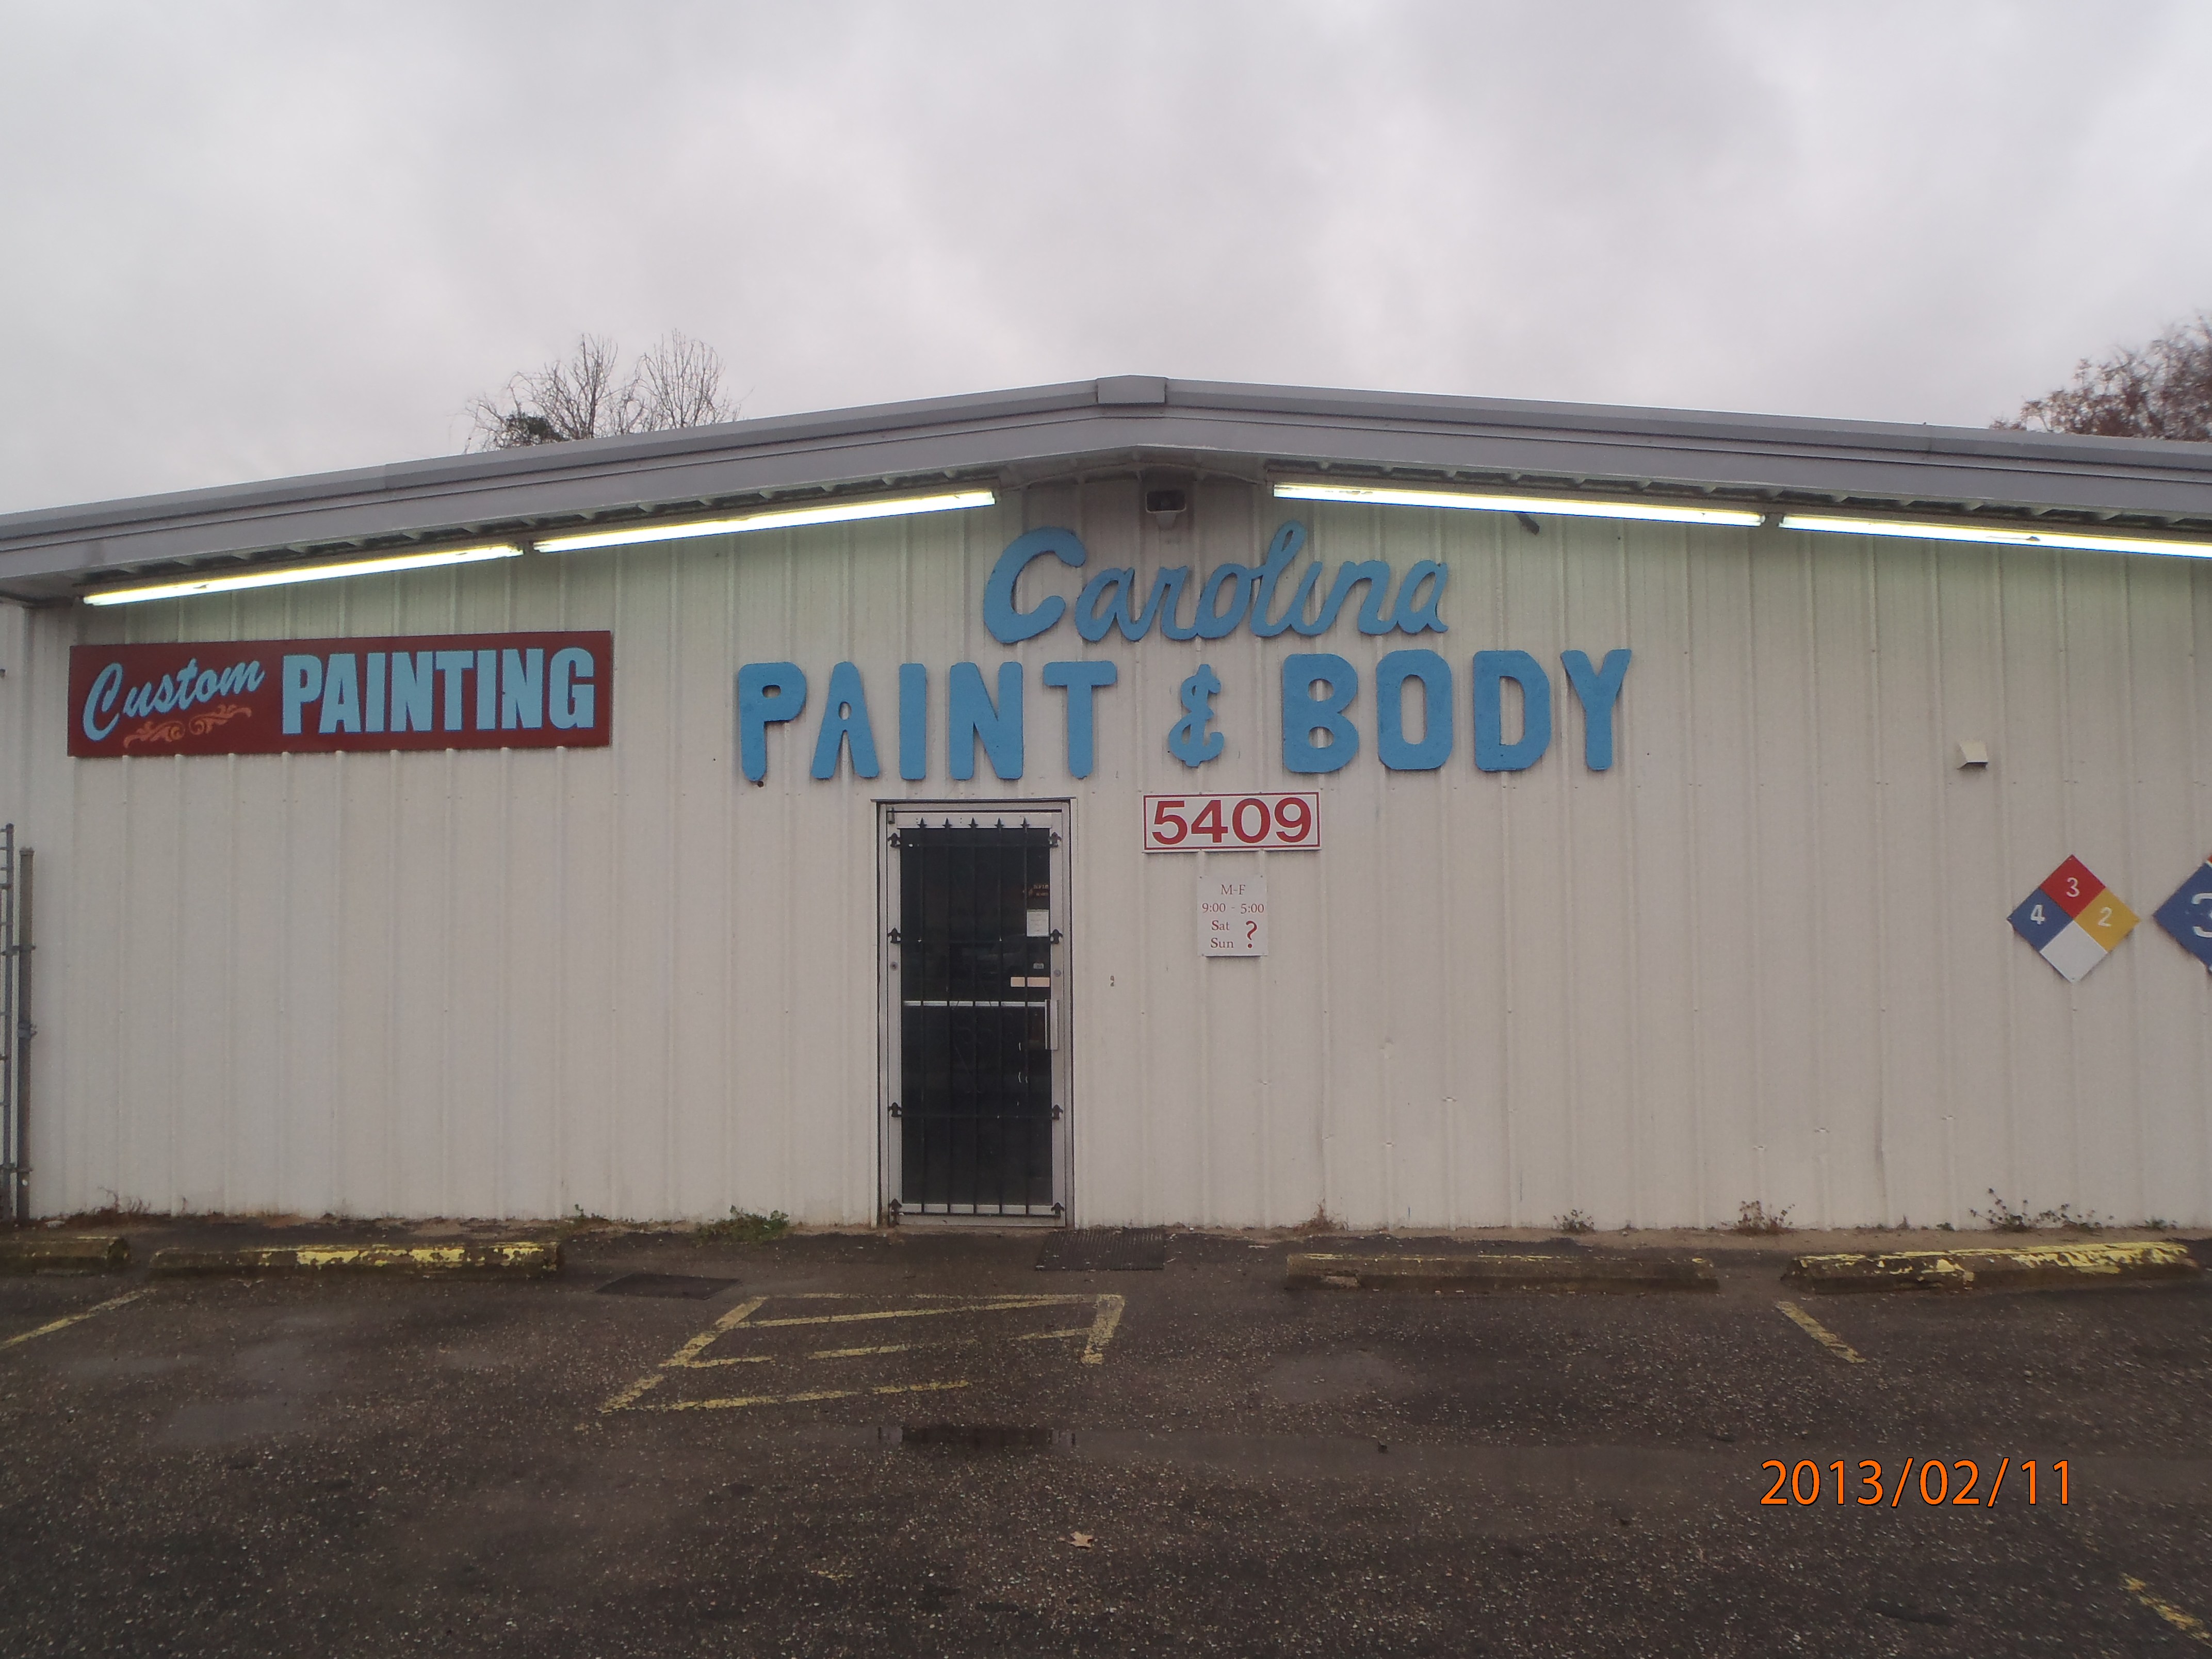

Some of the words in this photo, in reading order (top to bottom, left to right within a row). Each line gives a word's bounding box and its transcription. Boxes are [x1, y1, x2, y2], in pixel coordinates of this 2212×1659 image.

[984, 520, 1449, 644] Carolina
[83, 659, 265, 741] Custom
[282, 646, 595, 735] PAINTING
[738, 661, 1117, 782] PAINT
[1167, 663, 1225, 768] &
[1282, 648, 1632, 773] BODY
[1151, 797, 1312, 845] 5409
[1220, 884, 1246, 896] M-F
[2065, 877, 2080, 898] 3
[1201, 902, 1226, 913] 9:00
[1240, 903, 1265, 914] 5:00
[2030, 904, 2045, 925] 4
[2097, 907, 2113, 927] 2
[1211, 920, 1230, 931] Sat
[1210, 937, 1234, 949] Sun
